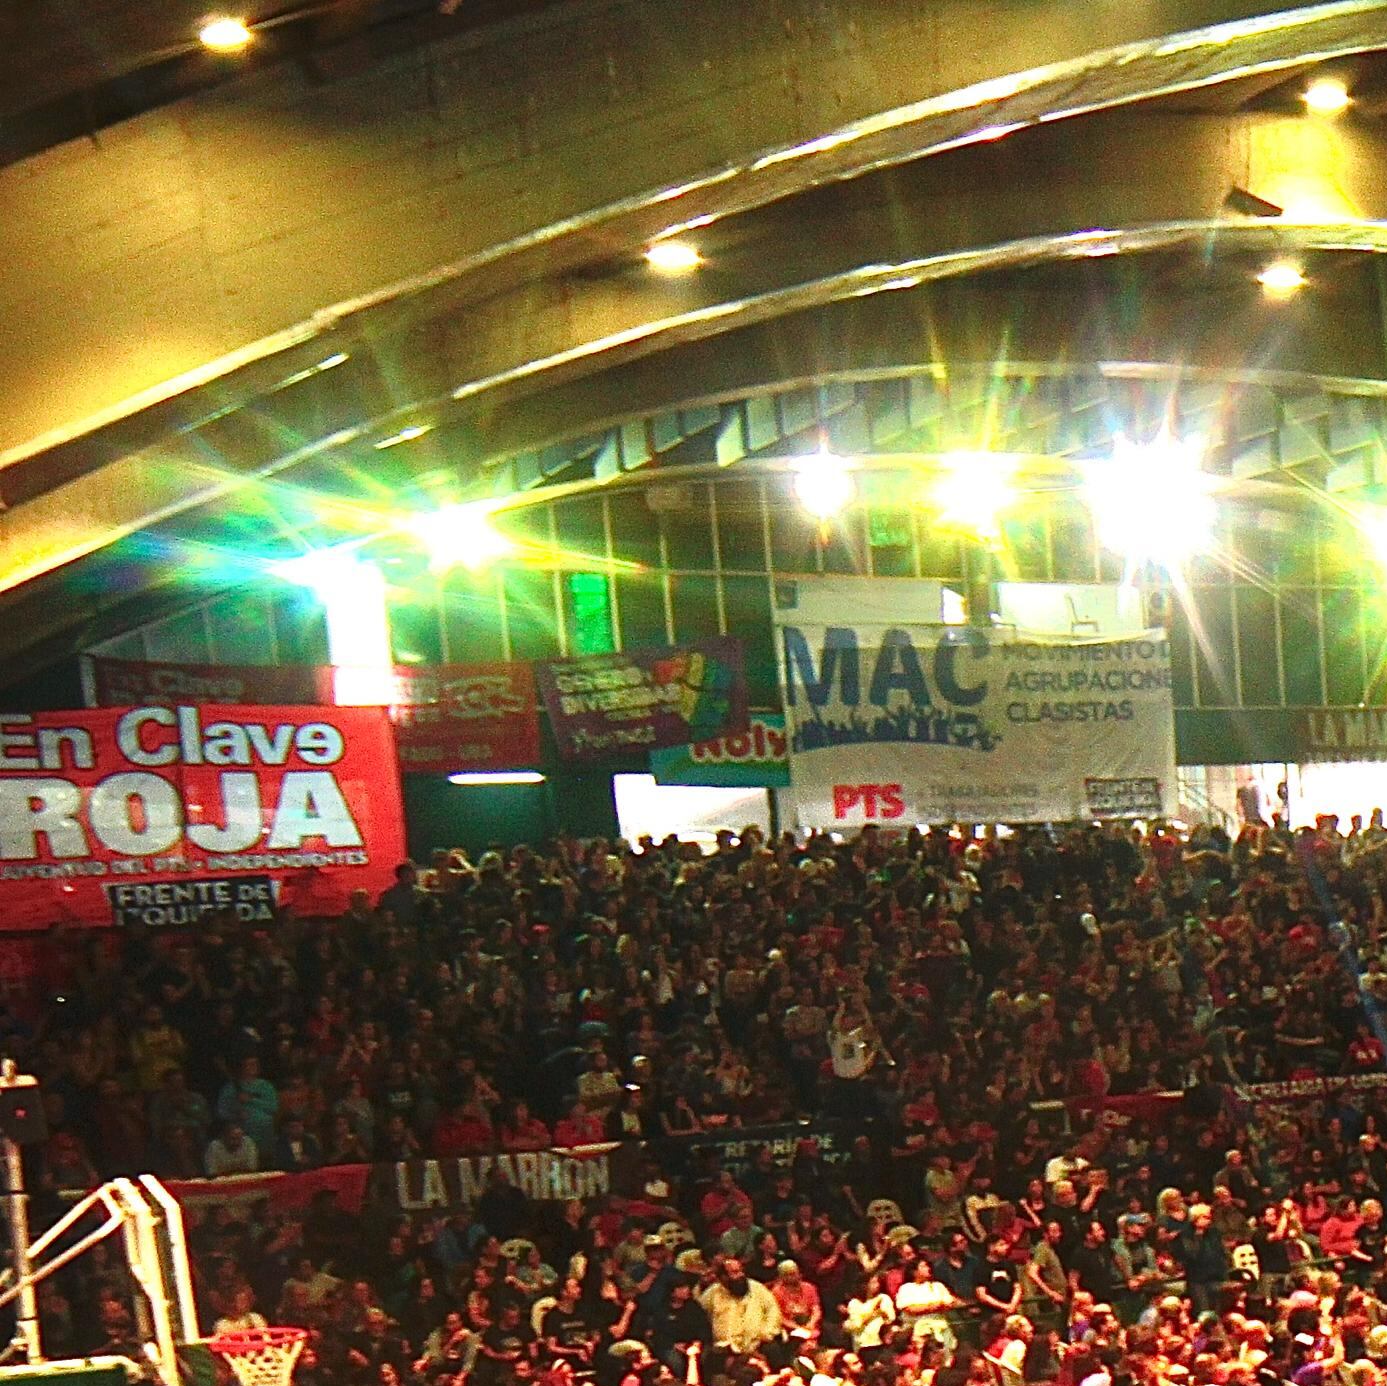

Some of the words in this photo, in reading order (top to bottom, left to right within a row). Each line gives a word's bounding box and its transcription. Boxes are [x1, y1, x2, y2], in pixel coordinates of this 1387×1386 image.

[782, 627, 991, 707] MAC
[0, 713, 95, 769] En
[117, 705, 344, 766] Clave
[1006, 702, 1134, 723] CLASISTAS
[0, 771, 366, 860] ROJA
[832, 783, 906, 820] PTS
[118, 881, 233, 905] FRENTE
[238, 883, 269, 900] DE
[396, 1158, 449, 1210] LA
